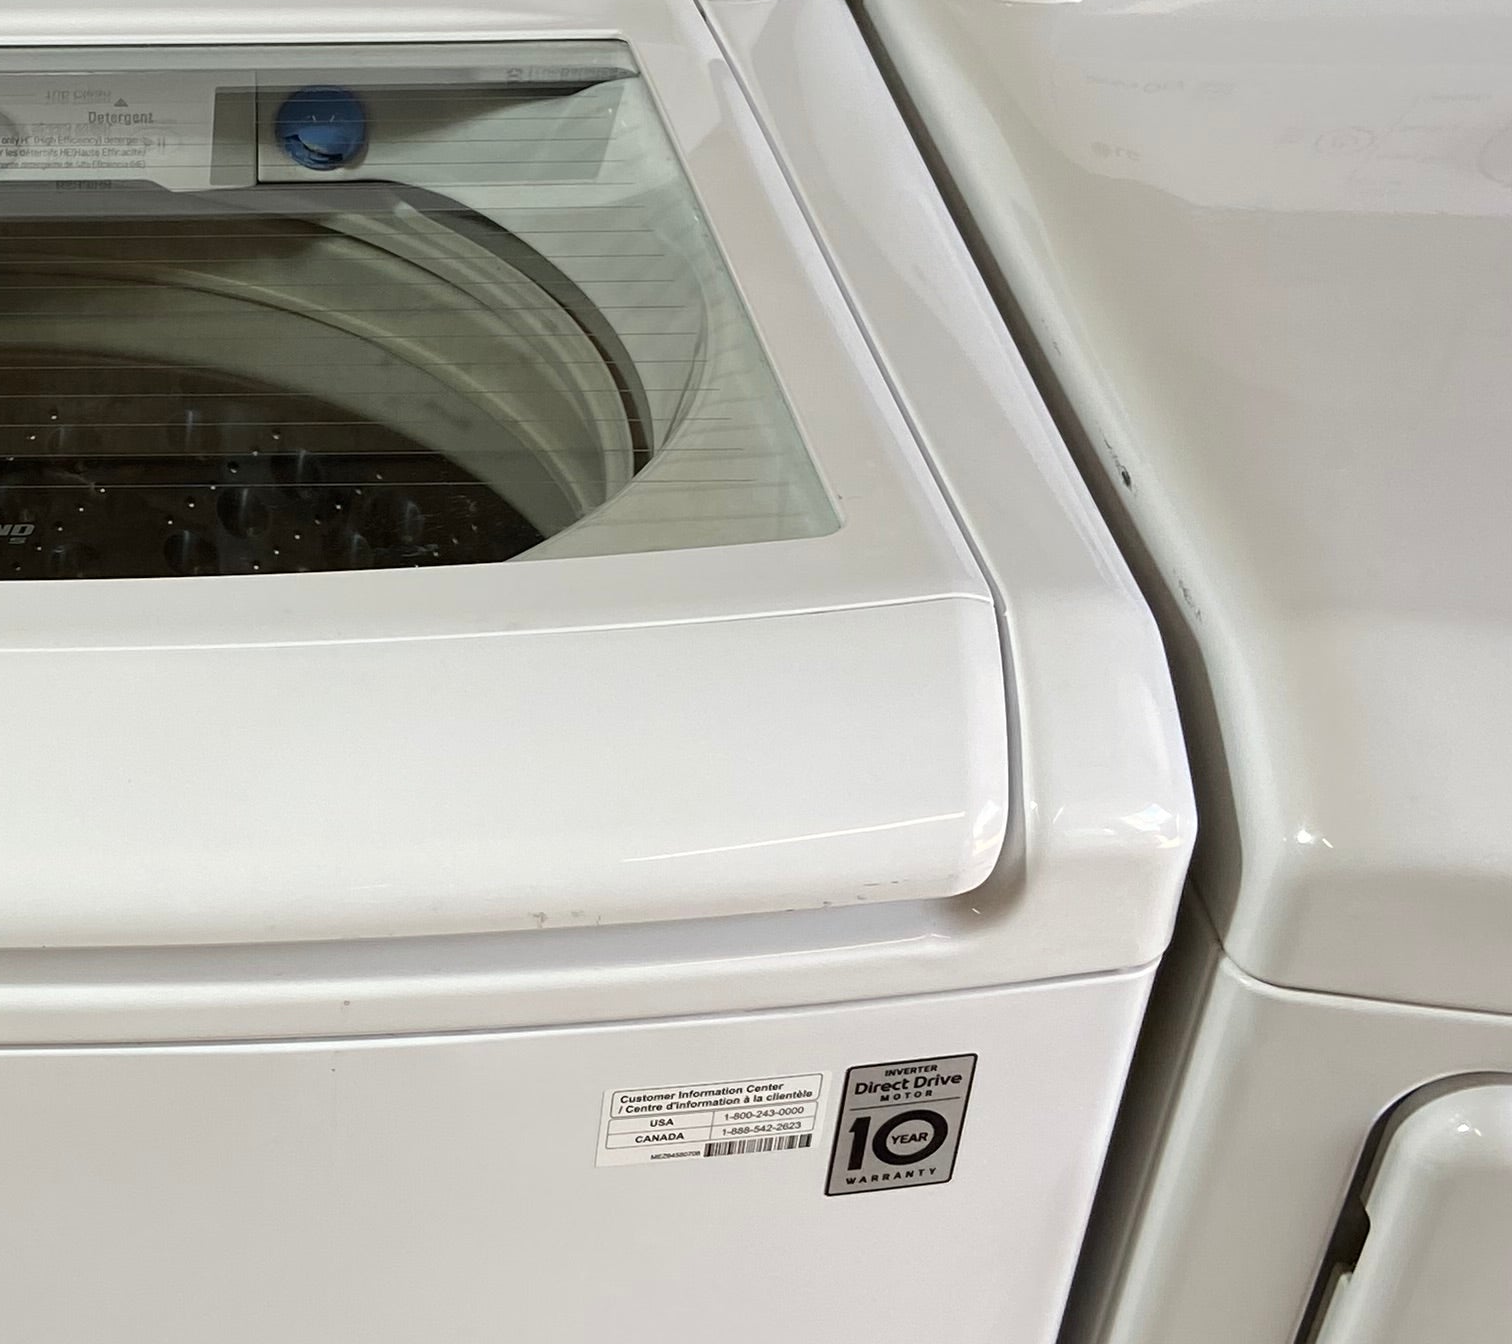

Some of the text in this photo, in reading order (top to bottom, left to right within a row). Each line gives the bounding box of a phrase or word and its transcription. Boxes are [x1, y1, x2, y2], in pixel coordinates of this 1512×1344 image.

[88, 111, 154, 126] Detergent
[884, 1064, 938, 1077] INVERTER
[854, 1071, 963, 1097] Direct Drive
[620, 1082, 784, 1104] Customer Information Center
[879, 1089, 935, 1103] MOTOR
[625, 1100, 664, 1113] Centre
[743, 1094, 750, 1104] à
[753, 1093, 763, 1103] la
[765, 1089, 813, 1102] clientèle
[724, 1105, 804, 1122] 1-800-243-0000
[649, 1117, 674, 1128] USA
[722, 1121, 802, 1136] 1-888-542-2623
[635, 1131, 685, 1144] CANADA
[847, 1108, 949, 1172] 10
[891, 1131, 929, 1146] YEAR
[846, 1167, 937, 1185] WARRANTY
